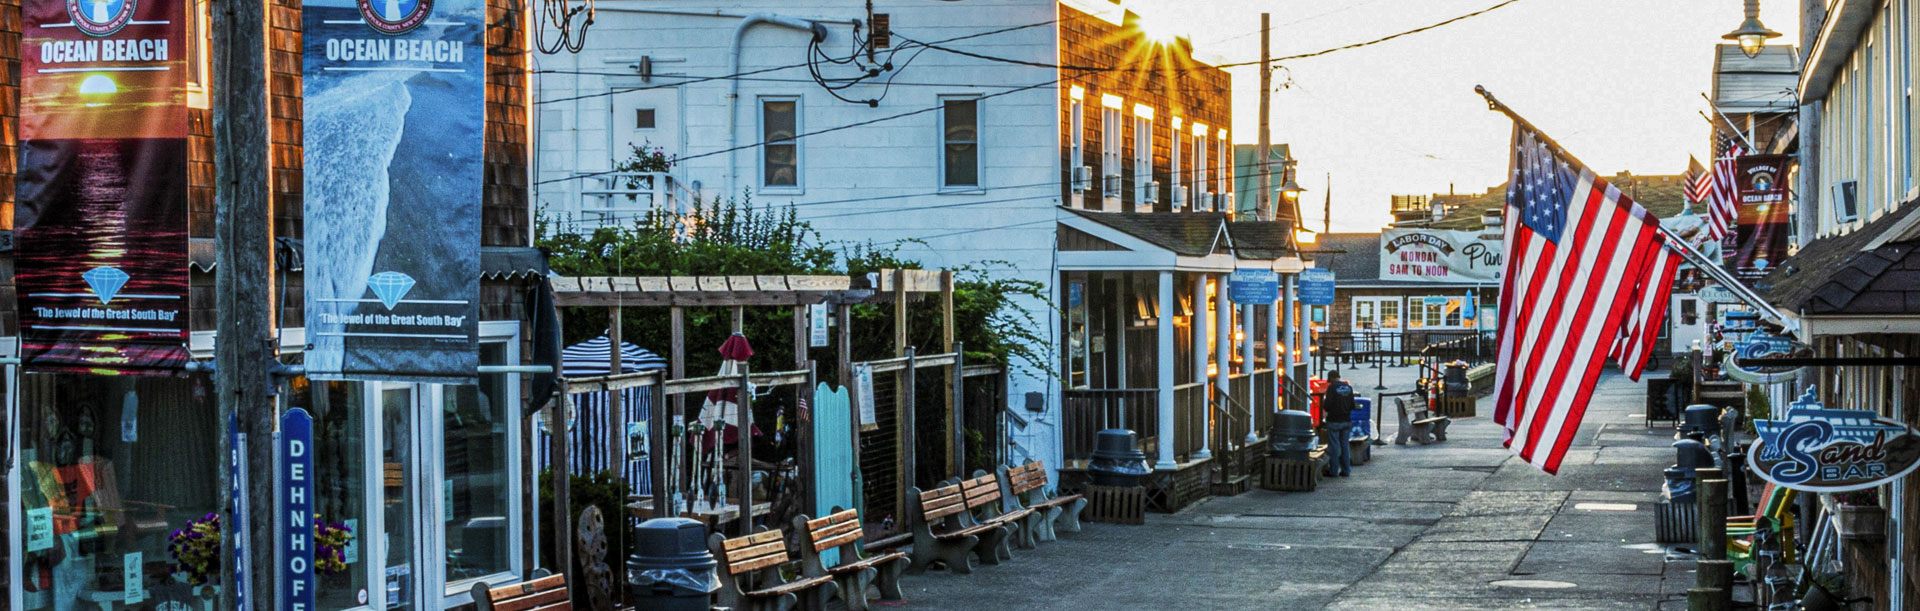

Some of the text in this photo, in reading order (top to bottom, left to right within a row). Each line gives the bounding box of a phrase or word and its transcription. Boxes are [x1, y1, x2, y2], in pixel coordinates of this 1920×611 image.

[41, 39, 168, 63] OCEAN BEACH
[326, 38, 464, 62] OCEAN BEACH
[1393, 234, 1448, 249] LABOR DAY
[1401, 251, 1437, 262] MONDAY
[1462, 243, 1502, 269] Pan
[1389, 264, 1448, 276] 9AM TO NOON
[1714, 290, 1735, 298] CASTL
[54, 307, 81, 319] Jewel
[81, 308, 91, 319] of
[91, 308, 105, 319] the
[106, 308, 130, 320] Great
[131, 309, 157, 320] South
[339, 313, 364, 324] Jewel
[364, 313, 374, 325] of
[374, 314, 390, 325] the
[391, 314, 415, 325] Great
[416, 315, 443, 326] South
[1759, 420, 1886, 484] the Sand
[1821, 463, 1888, 481] BAR
[231, 449, 240, 515] BAY
